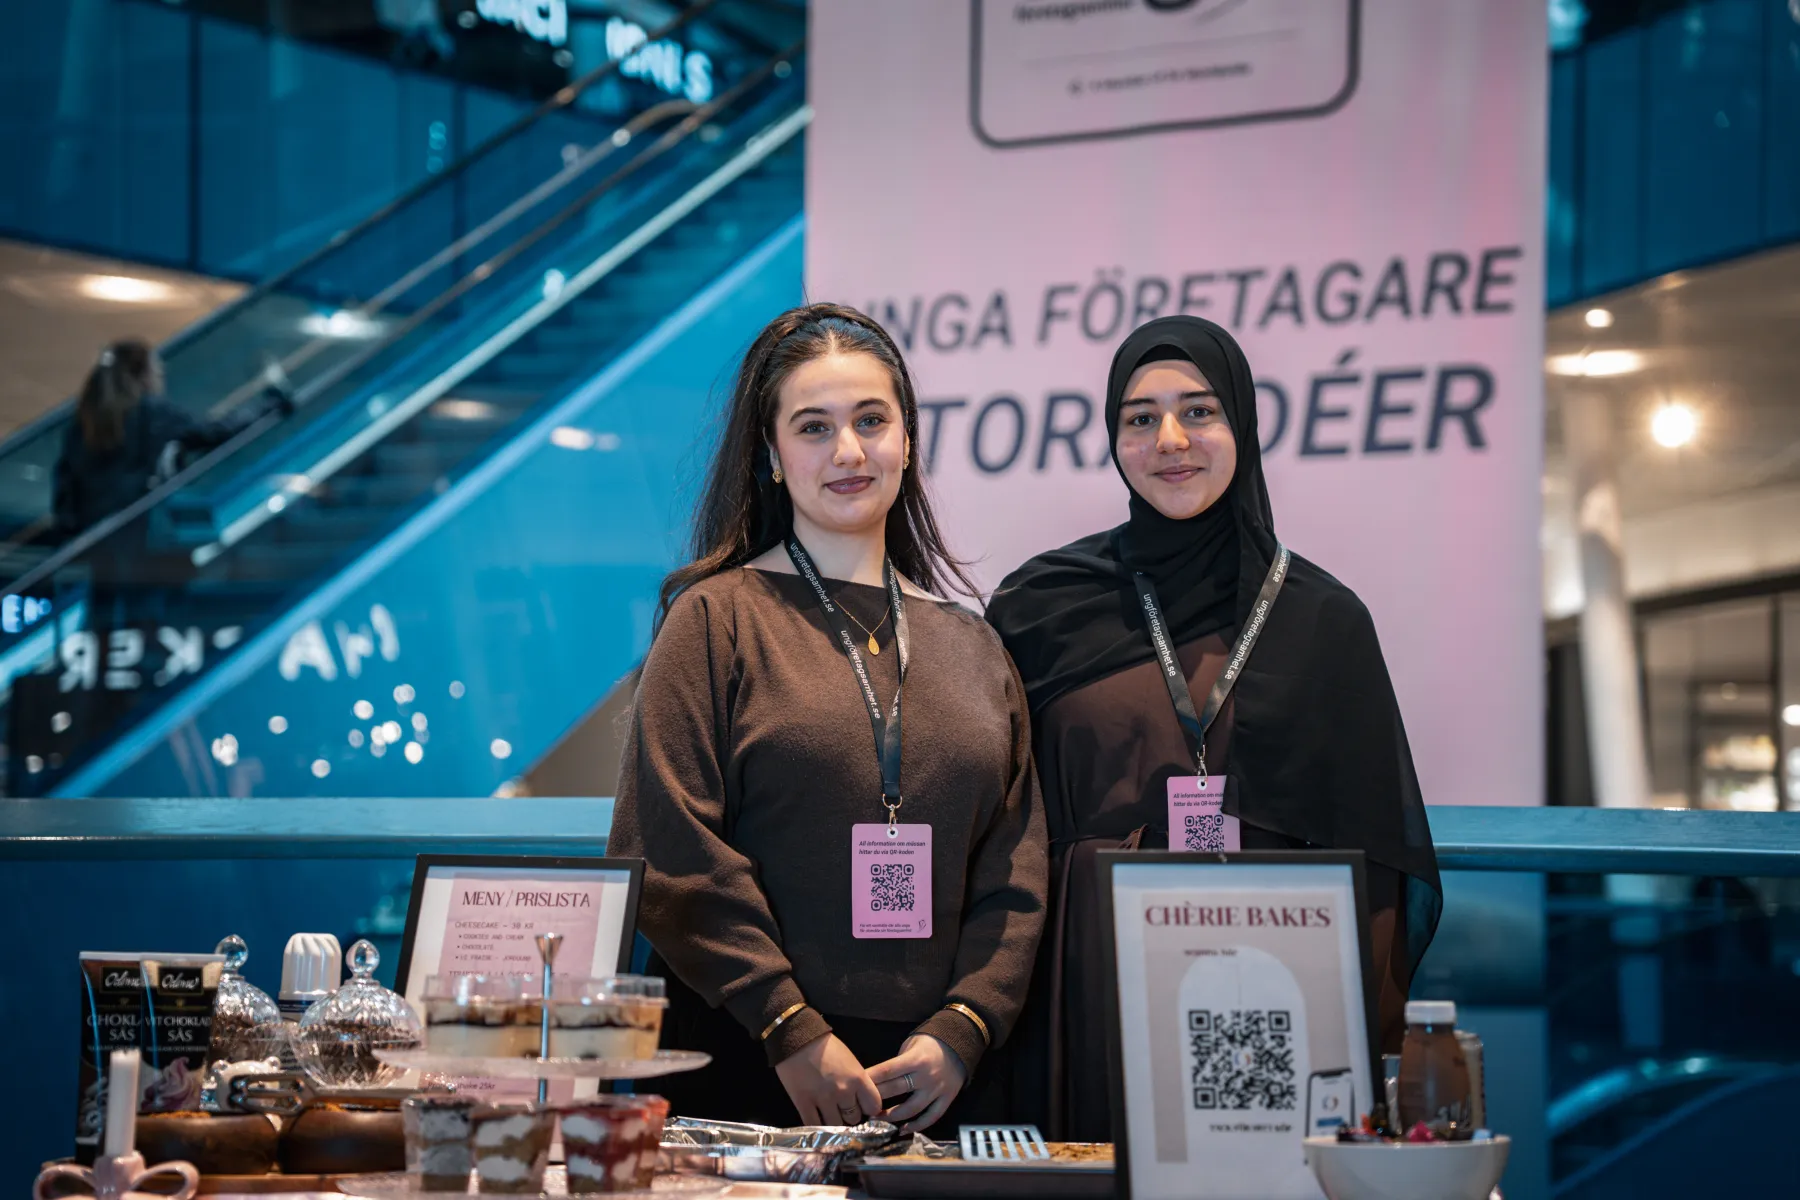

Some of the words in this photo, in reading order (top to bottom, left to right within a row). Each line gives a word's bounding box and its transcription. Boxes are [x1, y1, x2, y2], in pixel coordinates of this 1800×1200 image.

[866, 286, 1014, 354] NGA
[1034, 245, 1524, 347] FÖRETAGARE
[917, 390, 1113, 477] TOR
[1254, 347, 1497, 461] DÉER
[790, 542, 835, 613] ungföretagsamhet.se
[1143, 593, 1176, 678] ungföretagsamhet.se
[1225, 600, 1269, 680] ungföretagsamhet.se
[840, 630, 881, 719] ungföretagsamhet.se
[454, 921, 499, 930] CHEESECAKE
[462, 890, 507, 908] MENY
[515, 891, 591, 908] PRISLISTA
[1145, 900, 1242, 927] CHÈRIE
[1247, 906, 1331, 928] BAKES
[87, 1014, 141, 1027] CHOKL
[167, 1028, 194, 1042] SÅS
